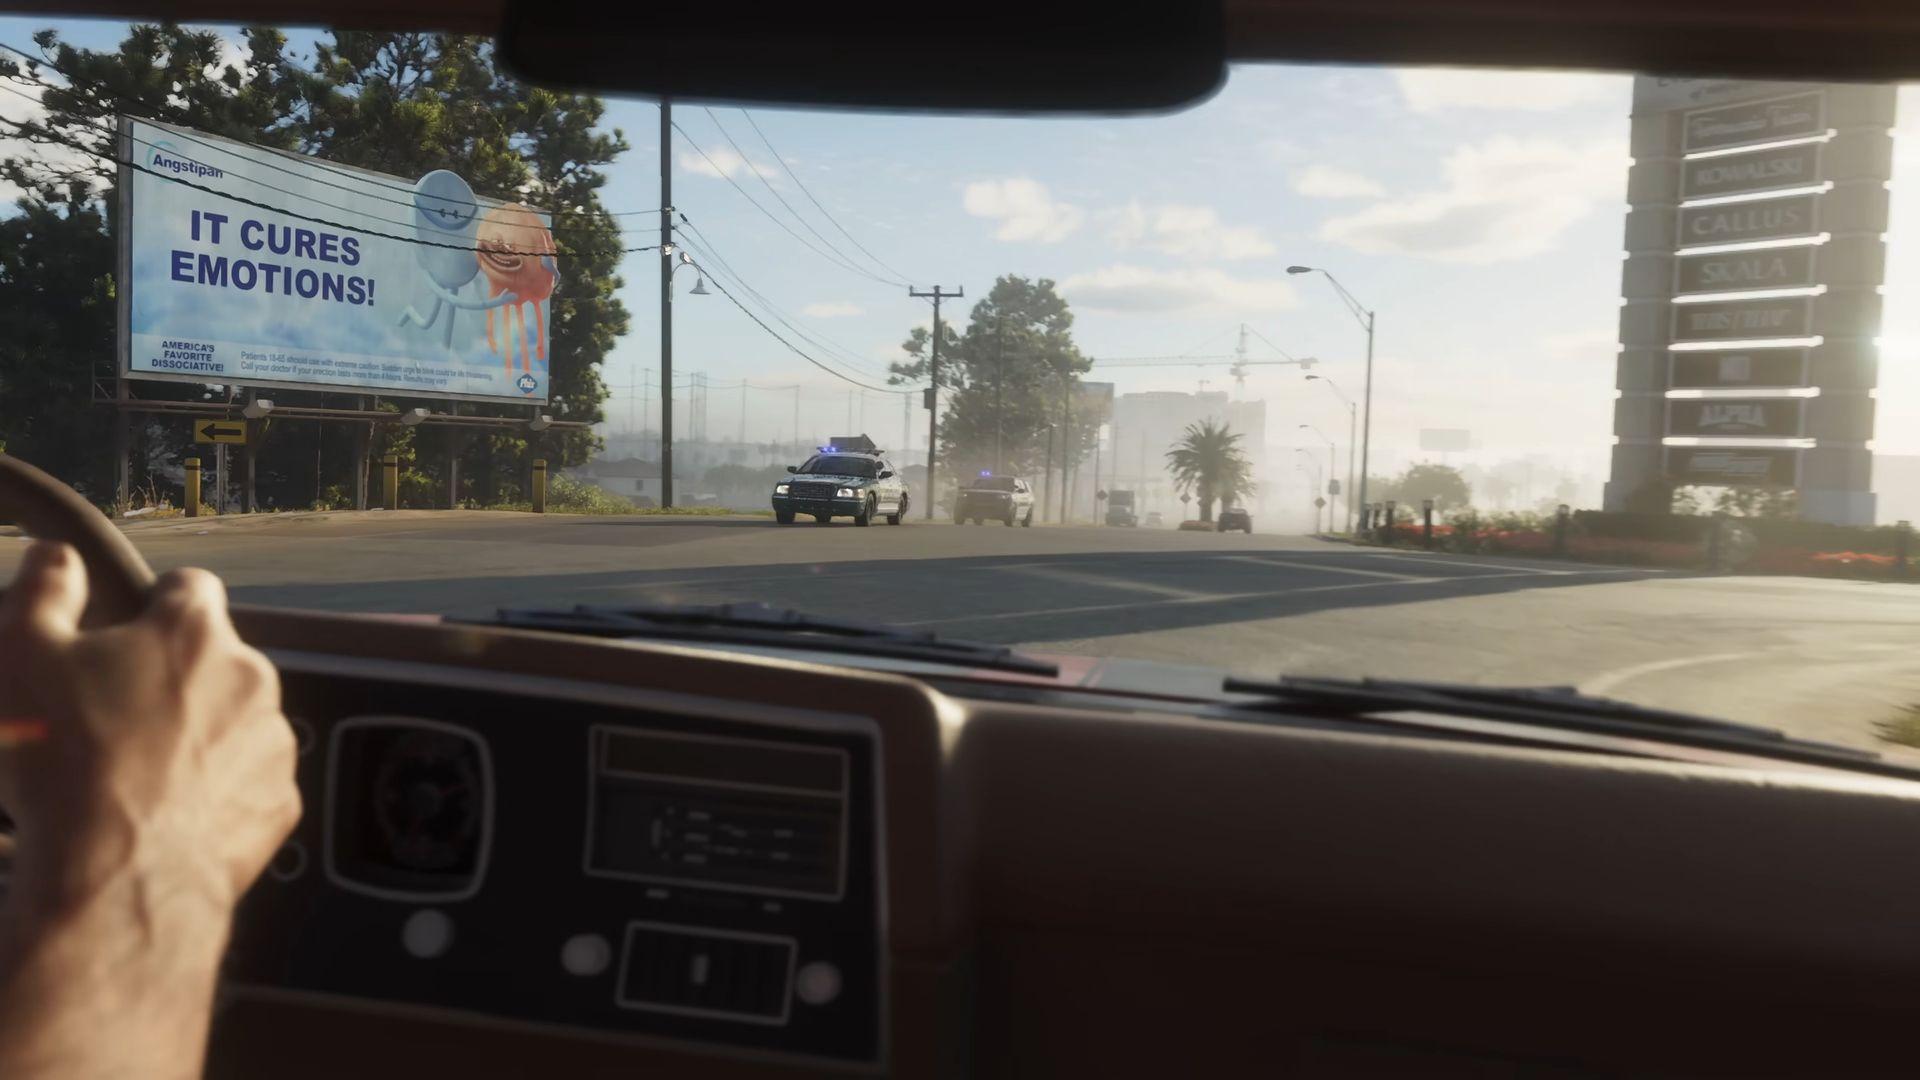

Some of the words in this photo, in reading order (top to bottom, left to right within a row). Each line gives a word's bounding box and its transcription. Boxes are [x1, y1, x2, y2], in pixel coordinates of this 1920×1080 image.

[153, 154, 223, 179] Angstipan
[1693, 207, 1799, 235] CALLUS
[191, 210, 228, 245] IT
[240, 219, 360, 266] CURES
[171, 249, 375, 306] EMOTIONS!
[1702, 257, 1788, 284] SKALA
[162, 341, 215, 353] AMERICA'S
[164, 350, 212, 362] FAVORITE
[152, 359, 224, 372] DISSOCIATIVE!
[241, 351, 267, 361] Patients
[334, 361, 357, 369] extreme
[241, 361, 253, 370] Call
[255, 365, 269, 373] your
[271, 365, 291, 373] doctor
[298, 367, 311, 376] your
[312, 368, 336, 377] erection
[337, 369, 351, 378] lasts
